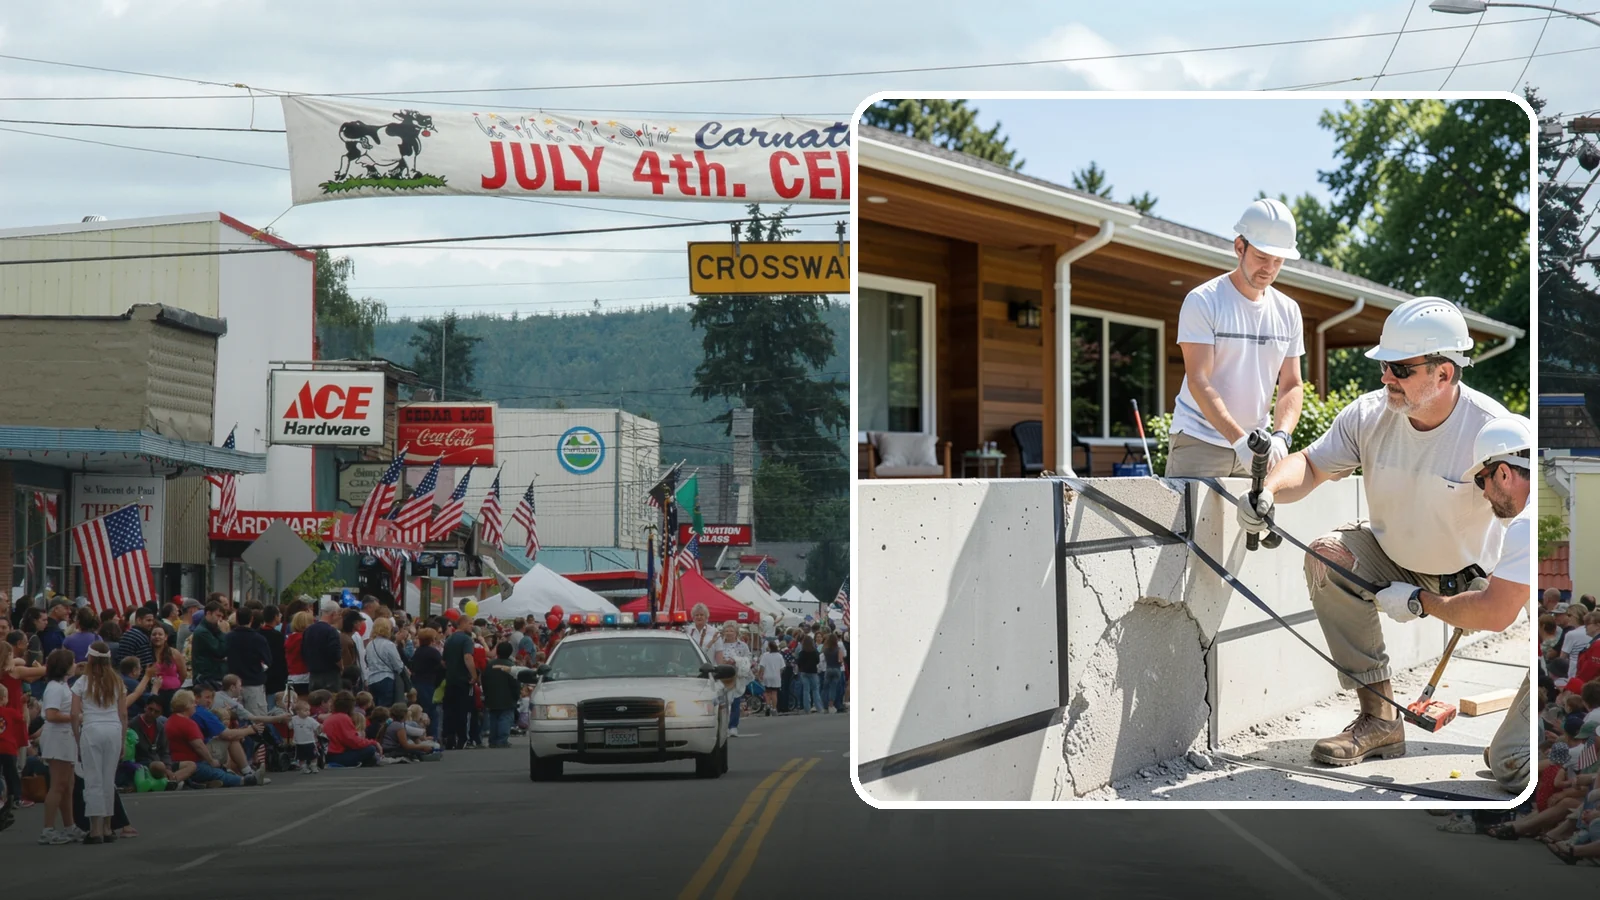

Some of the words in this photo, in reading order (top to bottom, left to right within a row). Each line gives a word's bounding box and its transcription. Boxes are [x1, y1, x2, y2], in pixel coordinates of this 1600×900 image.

[481, 140, 604, 193] JULY
[632, 149, 746, 198] 4th.
[696, 254, 850, 280] CROSSWA
[282, 379, 374, 420] ACE
[406, 409, 453, 422] CEDAR
[461, 409, 485, 422] LOG
[283, 421, 371, 436] Hardware
[416, 428, 477, 447] Coca-Cola
[353, 467, 385, 479] Simpl
[96, 485, 124, 494] Vincent
[126, 485, 135, 494] de
[137, 485, 155, 495] Paul
[80, 503, 154, 522] THT
[688, 526, 741, 535] CRNATION
[699, 535, 730, 543] GLASS
